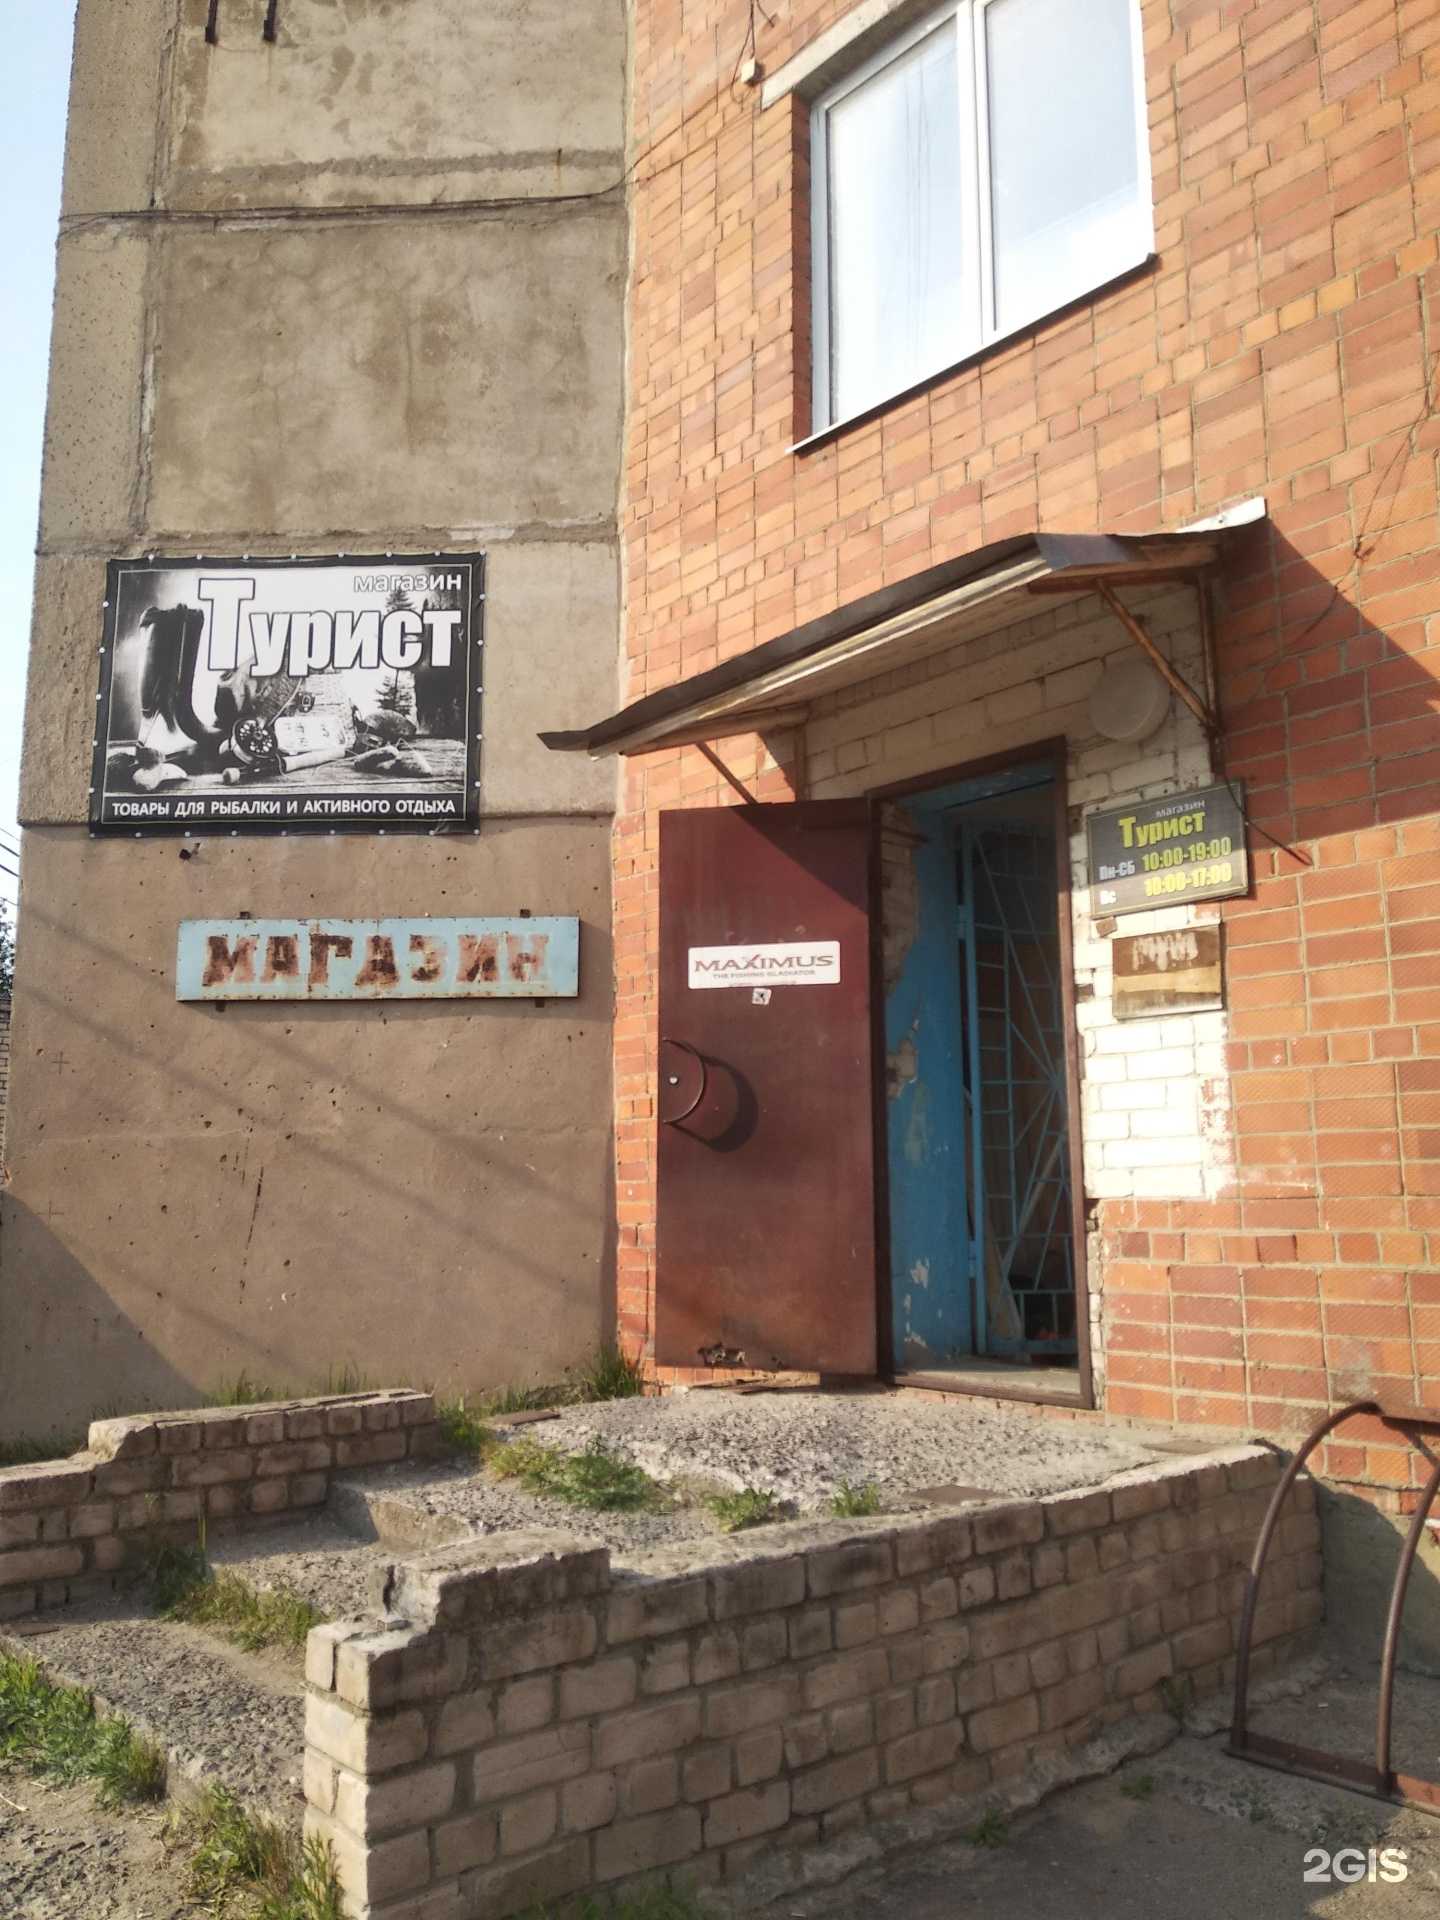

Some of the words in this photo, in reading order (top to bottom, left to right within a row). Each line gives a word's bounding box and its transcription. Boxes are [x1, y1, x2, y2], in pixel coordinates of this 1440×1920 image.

[353, 574, 462, 592] магазин
[197, 578, 463, 677] Турист
[112, 801, 170, 817] ТОВАРЫ
[174, 801, 205, 818] ДЛЯ
[211, 800, 281, 816] РЫБАЛКИ
[286, 800, 298, 815] И
[303, 799, 390, 815] АКТИВНОГО
[395, 800, 455, 816] ОТДЫХА
[1118, 812, 1206, 848] Турист
[1142, 836, 1232, 872] 10:00-19:00
[201, 934, 549, 987] МАГАЗИН
[694, 954, 834, 972] MAXIMUS
